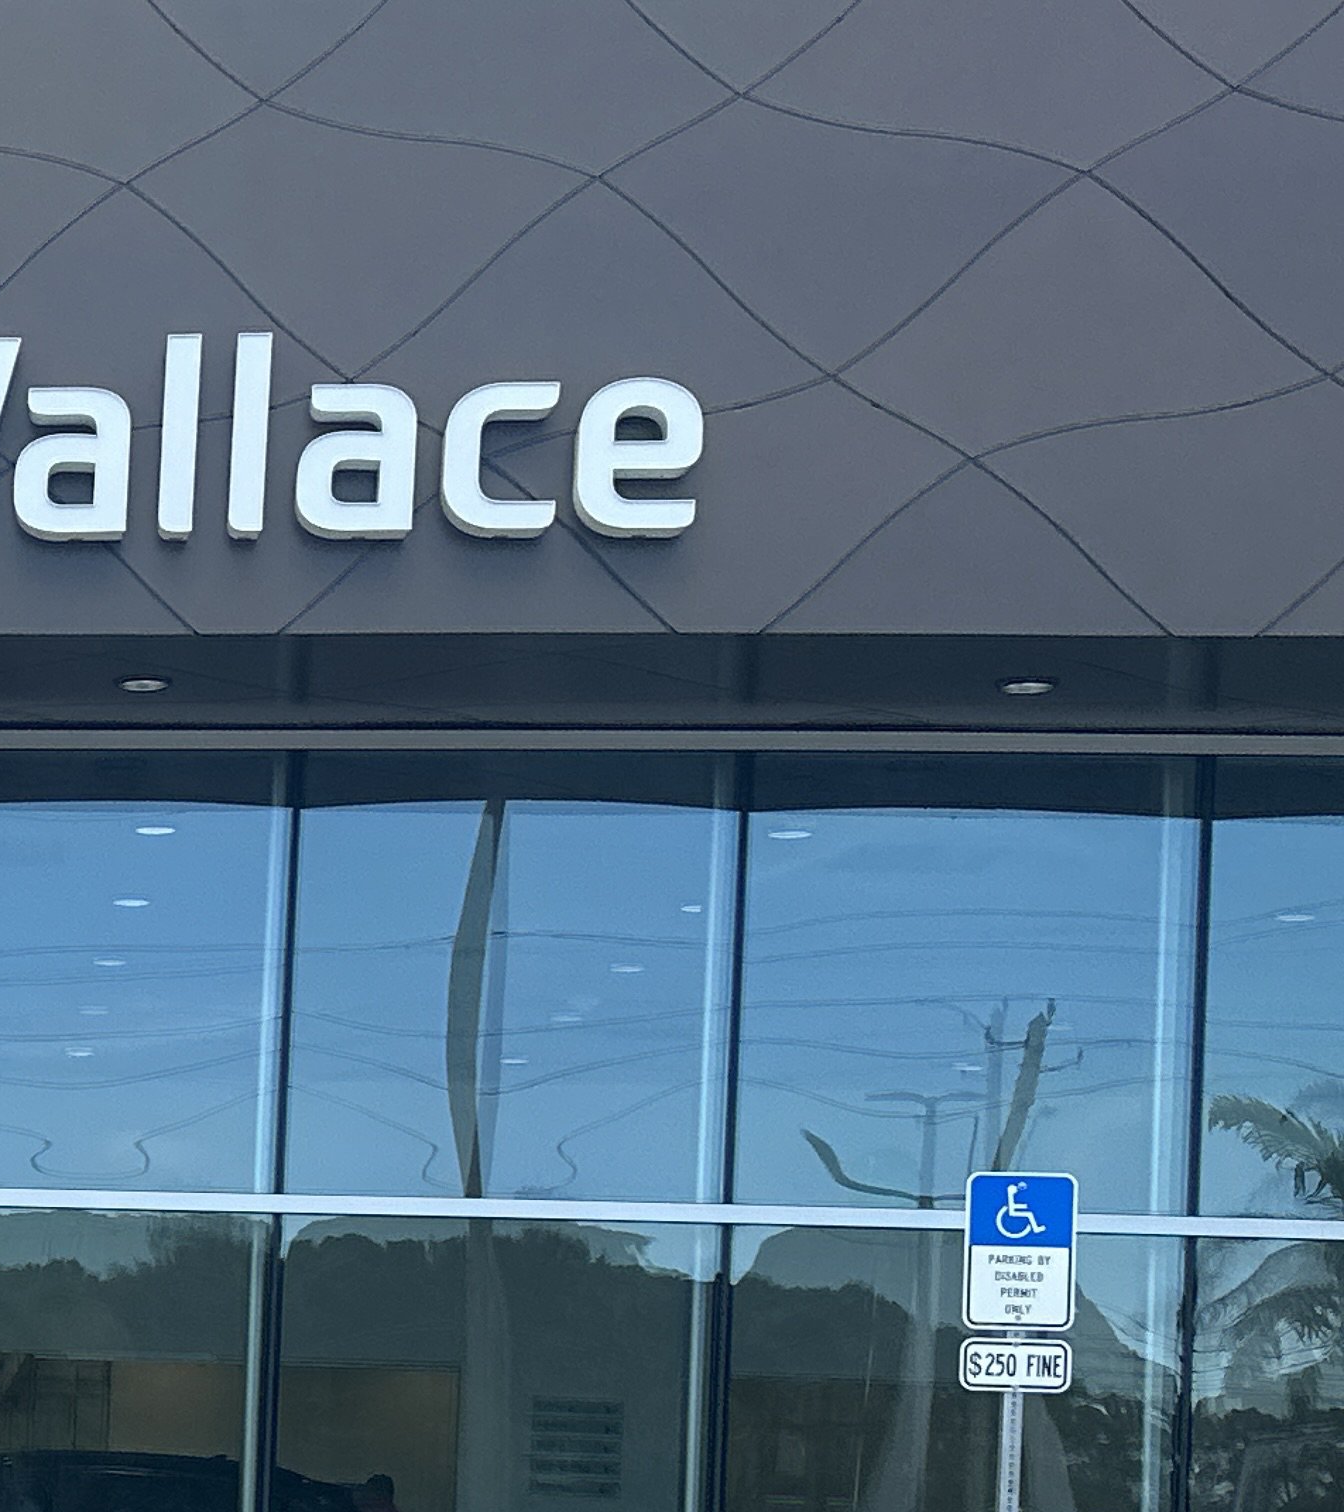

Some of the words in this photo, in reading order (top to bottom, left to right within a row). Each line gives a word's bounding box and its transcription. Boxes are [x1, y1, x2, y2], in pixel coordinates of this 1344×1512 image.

[988, 1254, 1032, 1265] PARKING
[1037, 1255, 1051, 1266] BY
[994, 1270, 1045, 1282] DISABLED
[1000, 1287, 1038, 1298] PERMIT
[1004, 1303, 1032, 1315] ONLY
[968, 1351, 1017, 1378] $250
[1026, 1354, 1062, 1379] FINE
